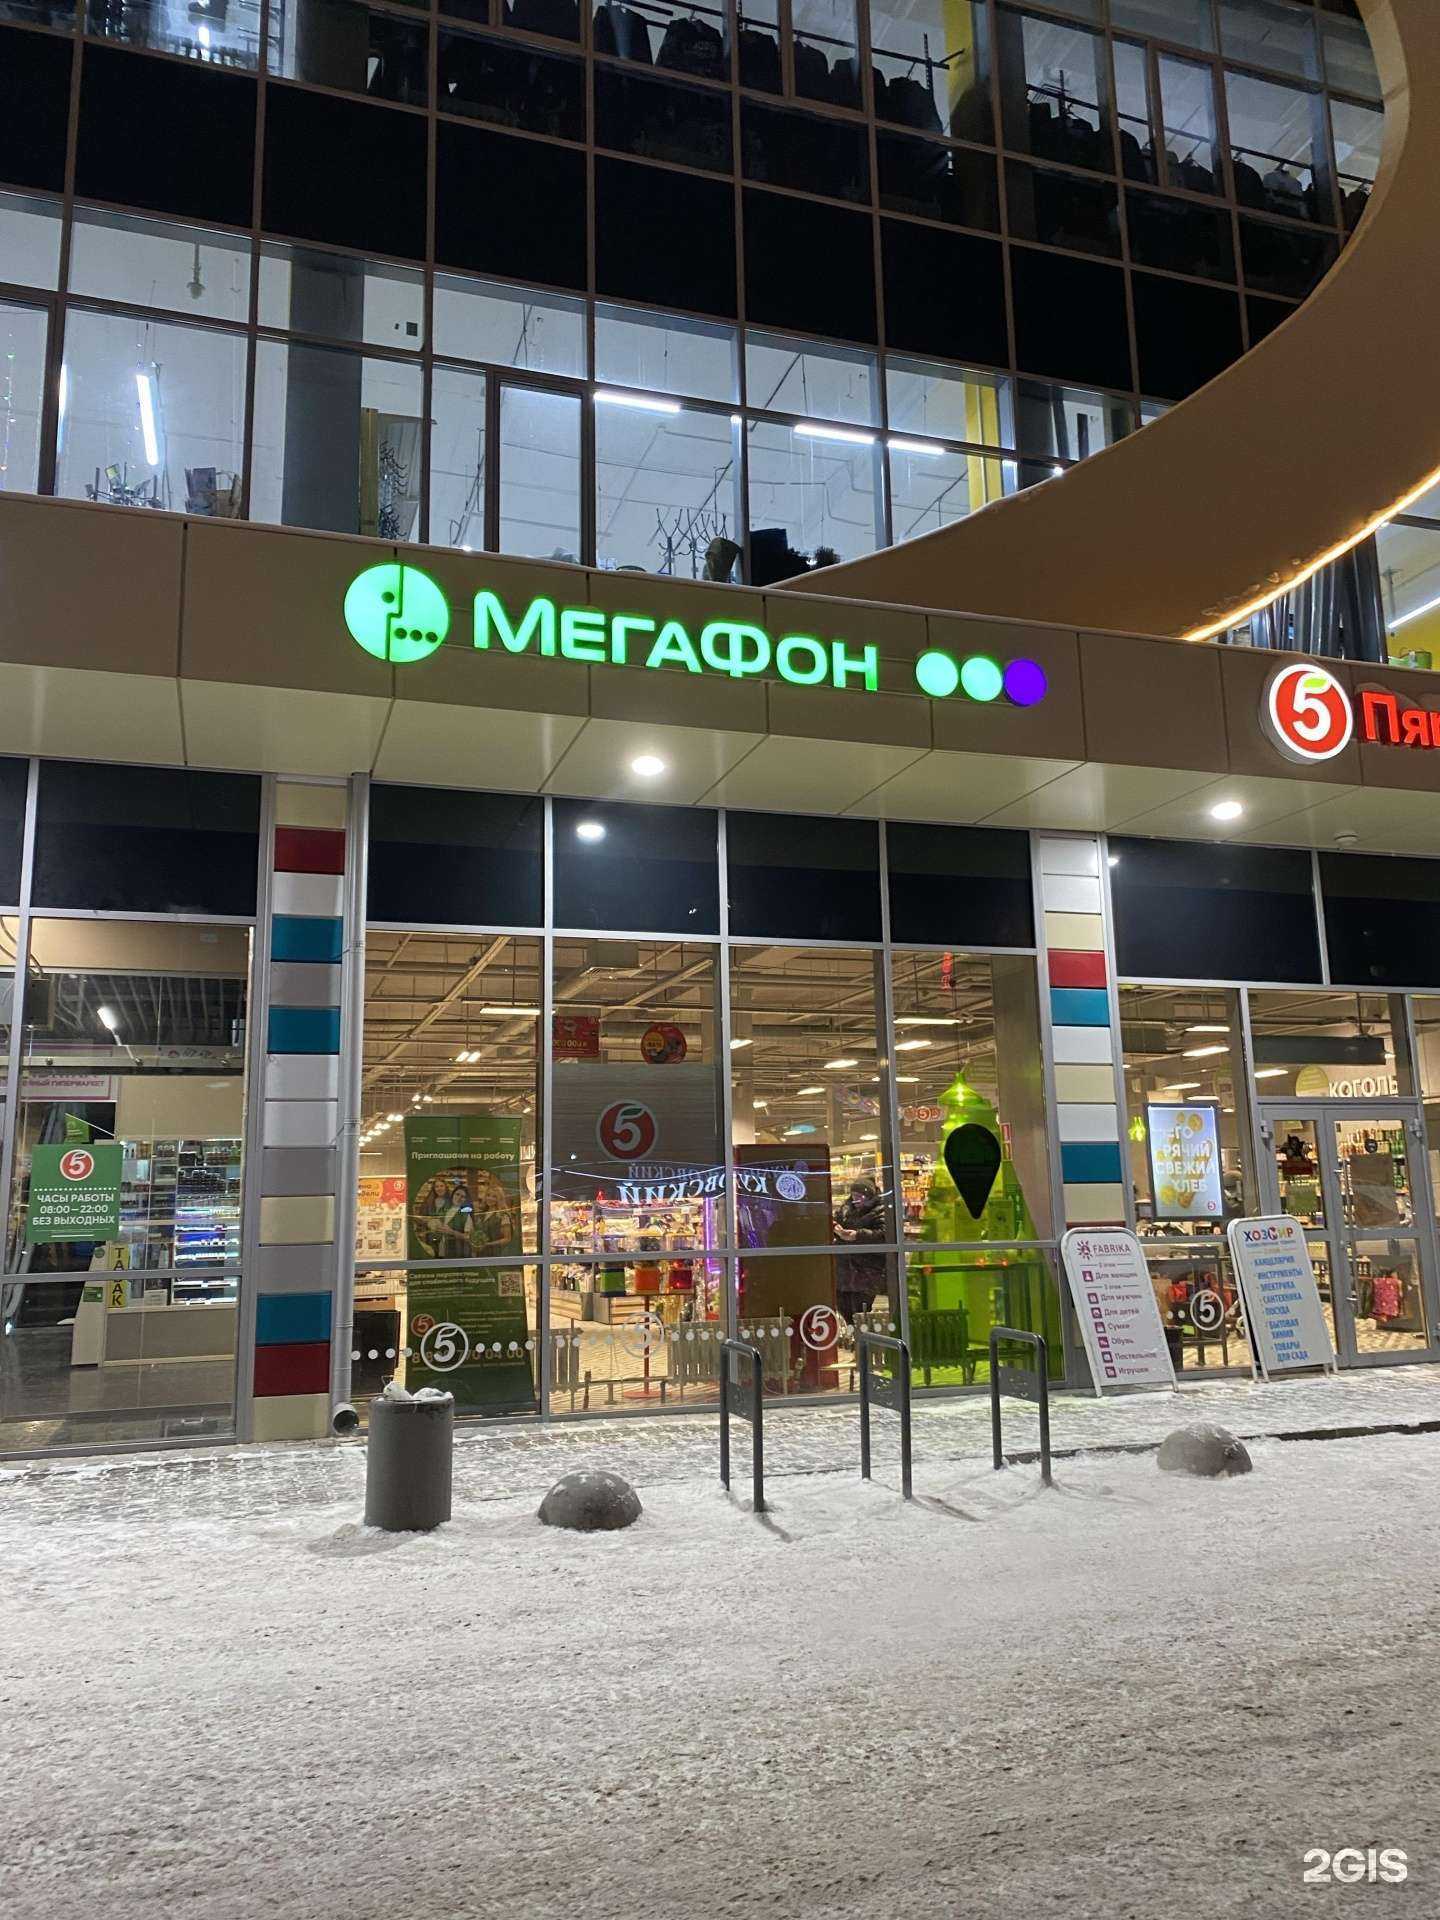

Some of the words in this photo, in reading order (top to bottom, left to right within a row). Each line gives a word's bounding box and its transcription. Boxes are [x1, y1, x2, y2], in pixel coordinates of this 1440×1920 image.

[473, 591, 877, 691] МЕГАФОН
[471, 1152, 482, 1160] на
[484, 1151, 515, 1162] работу
[37, 1193, 68, 1203] ЧАСЫ
[71, 1192, 114, 1203] РАБОТЫ
[32, 1216, 51, 1226] БЕЗ
[54, 1215, 115, 1226] ВЫХОДНЫХ
[1092, 1243, 1132, 1254] FABRIKA
[111, 1247, 126, 1306] ТААК
[1260, 1281, 1296, 1292] ЭЛЕКТРИКА
[1101, 1294, 1115, 1302] Для
[1263, 1292, 1303, 1304] САНТЕХНИКА
[1104, 1308, 1118, 1316] Для
[1107, 1323, 1130, 1331] Сумки
[1111, 1337, 1134, 1345] Обувь
